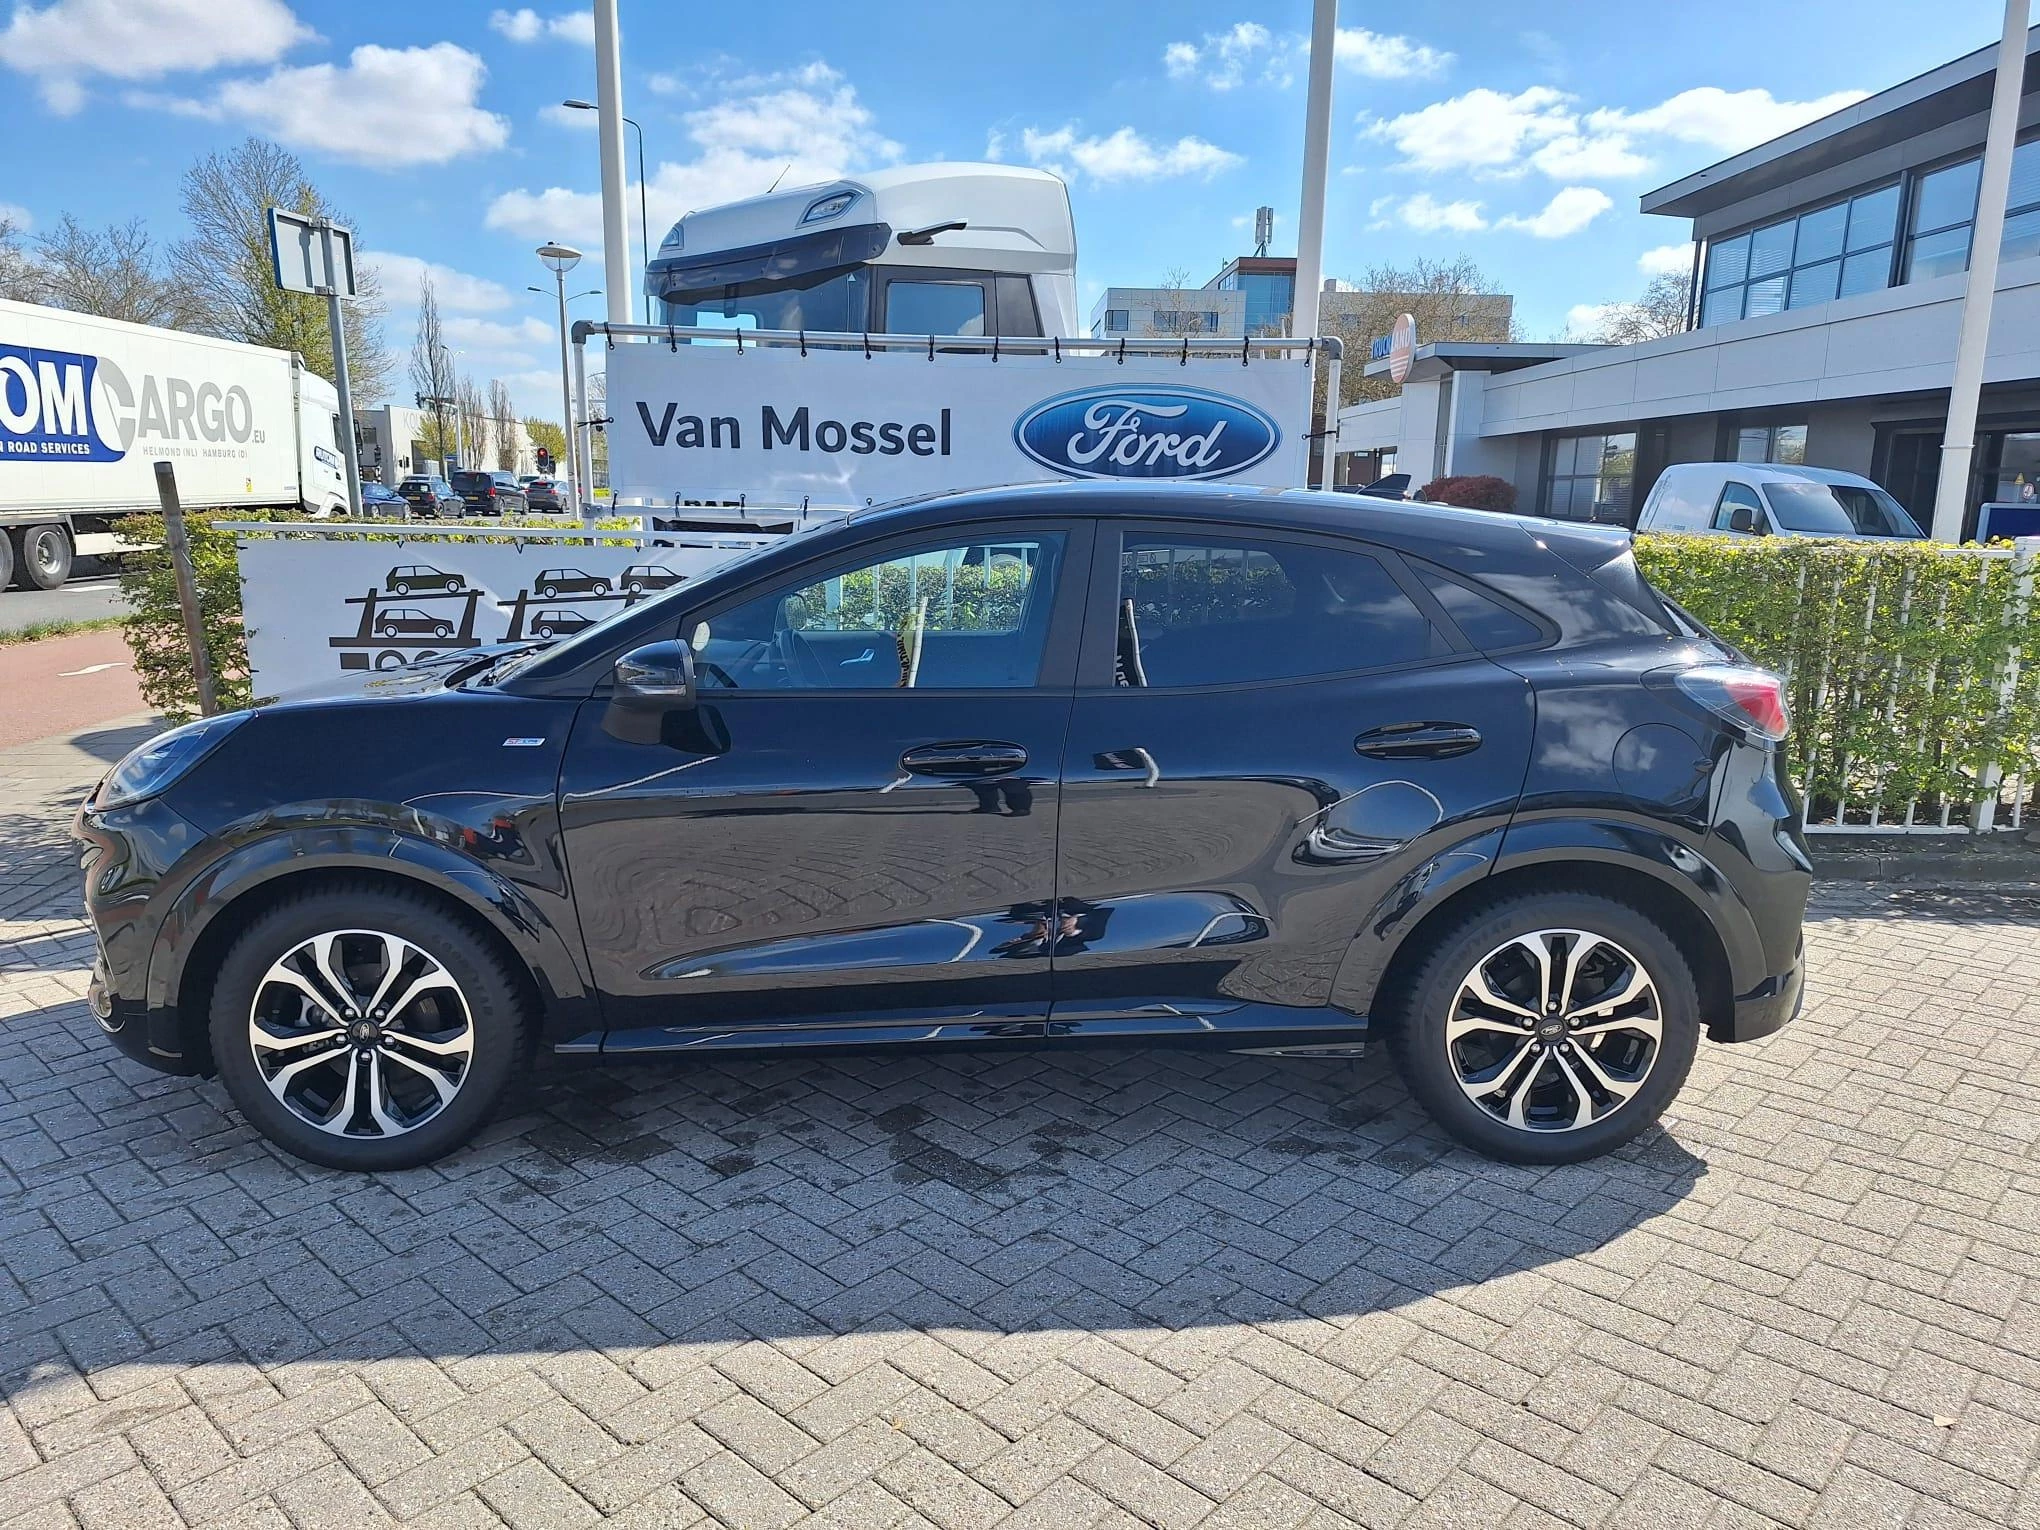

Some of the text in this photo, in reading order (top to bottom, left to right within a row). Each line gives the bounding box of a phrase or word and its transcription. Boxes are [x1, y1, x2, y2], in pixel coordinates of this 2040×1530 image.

[636, 400, 1227, 467] Van Mossel Ford
[8, 441, 37, 453] ROAD
[41, 442, 90, 454] SERVICES
[143, 446, 181, 457] HELMOND
[203, 448, 236, 458] HAMBURG
